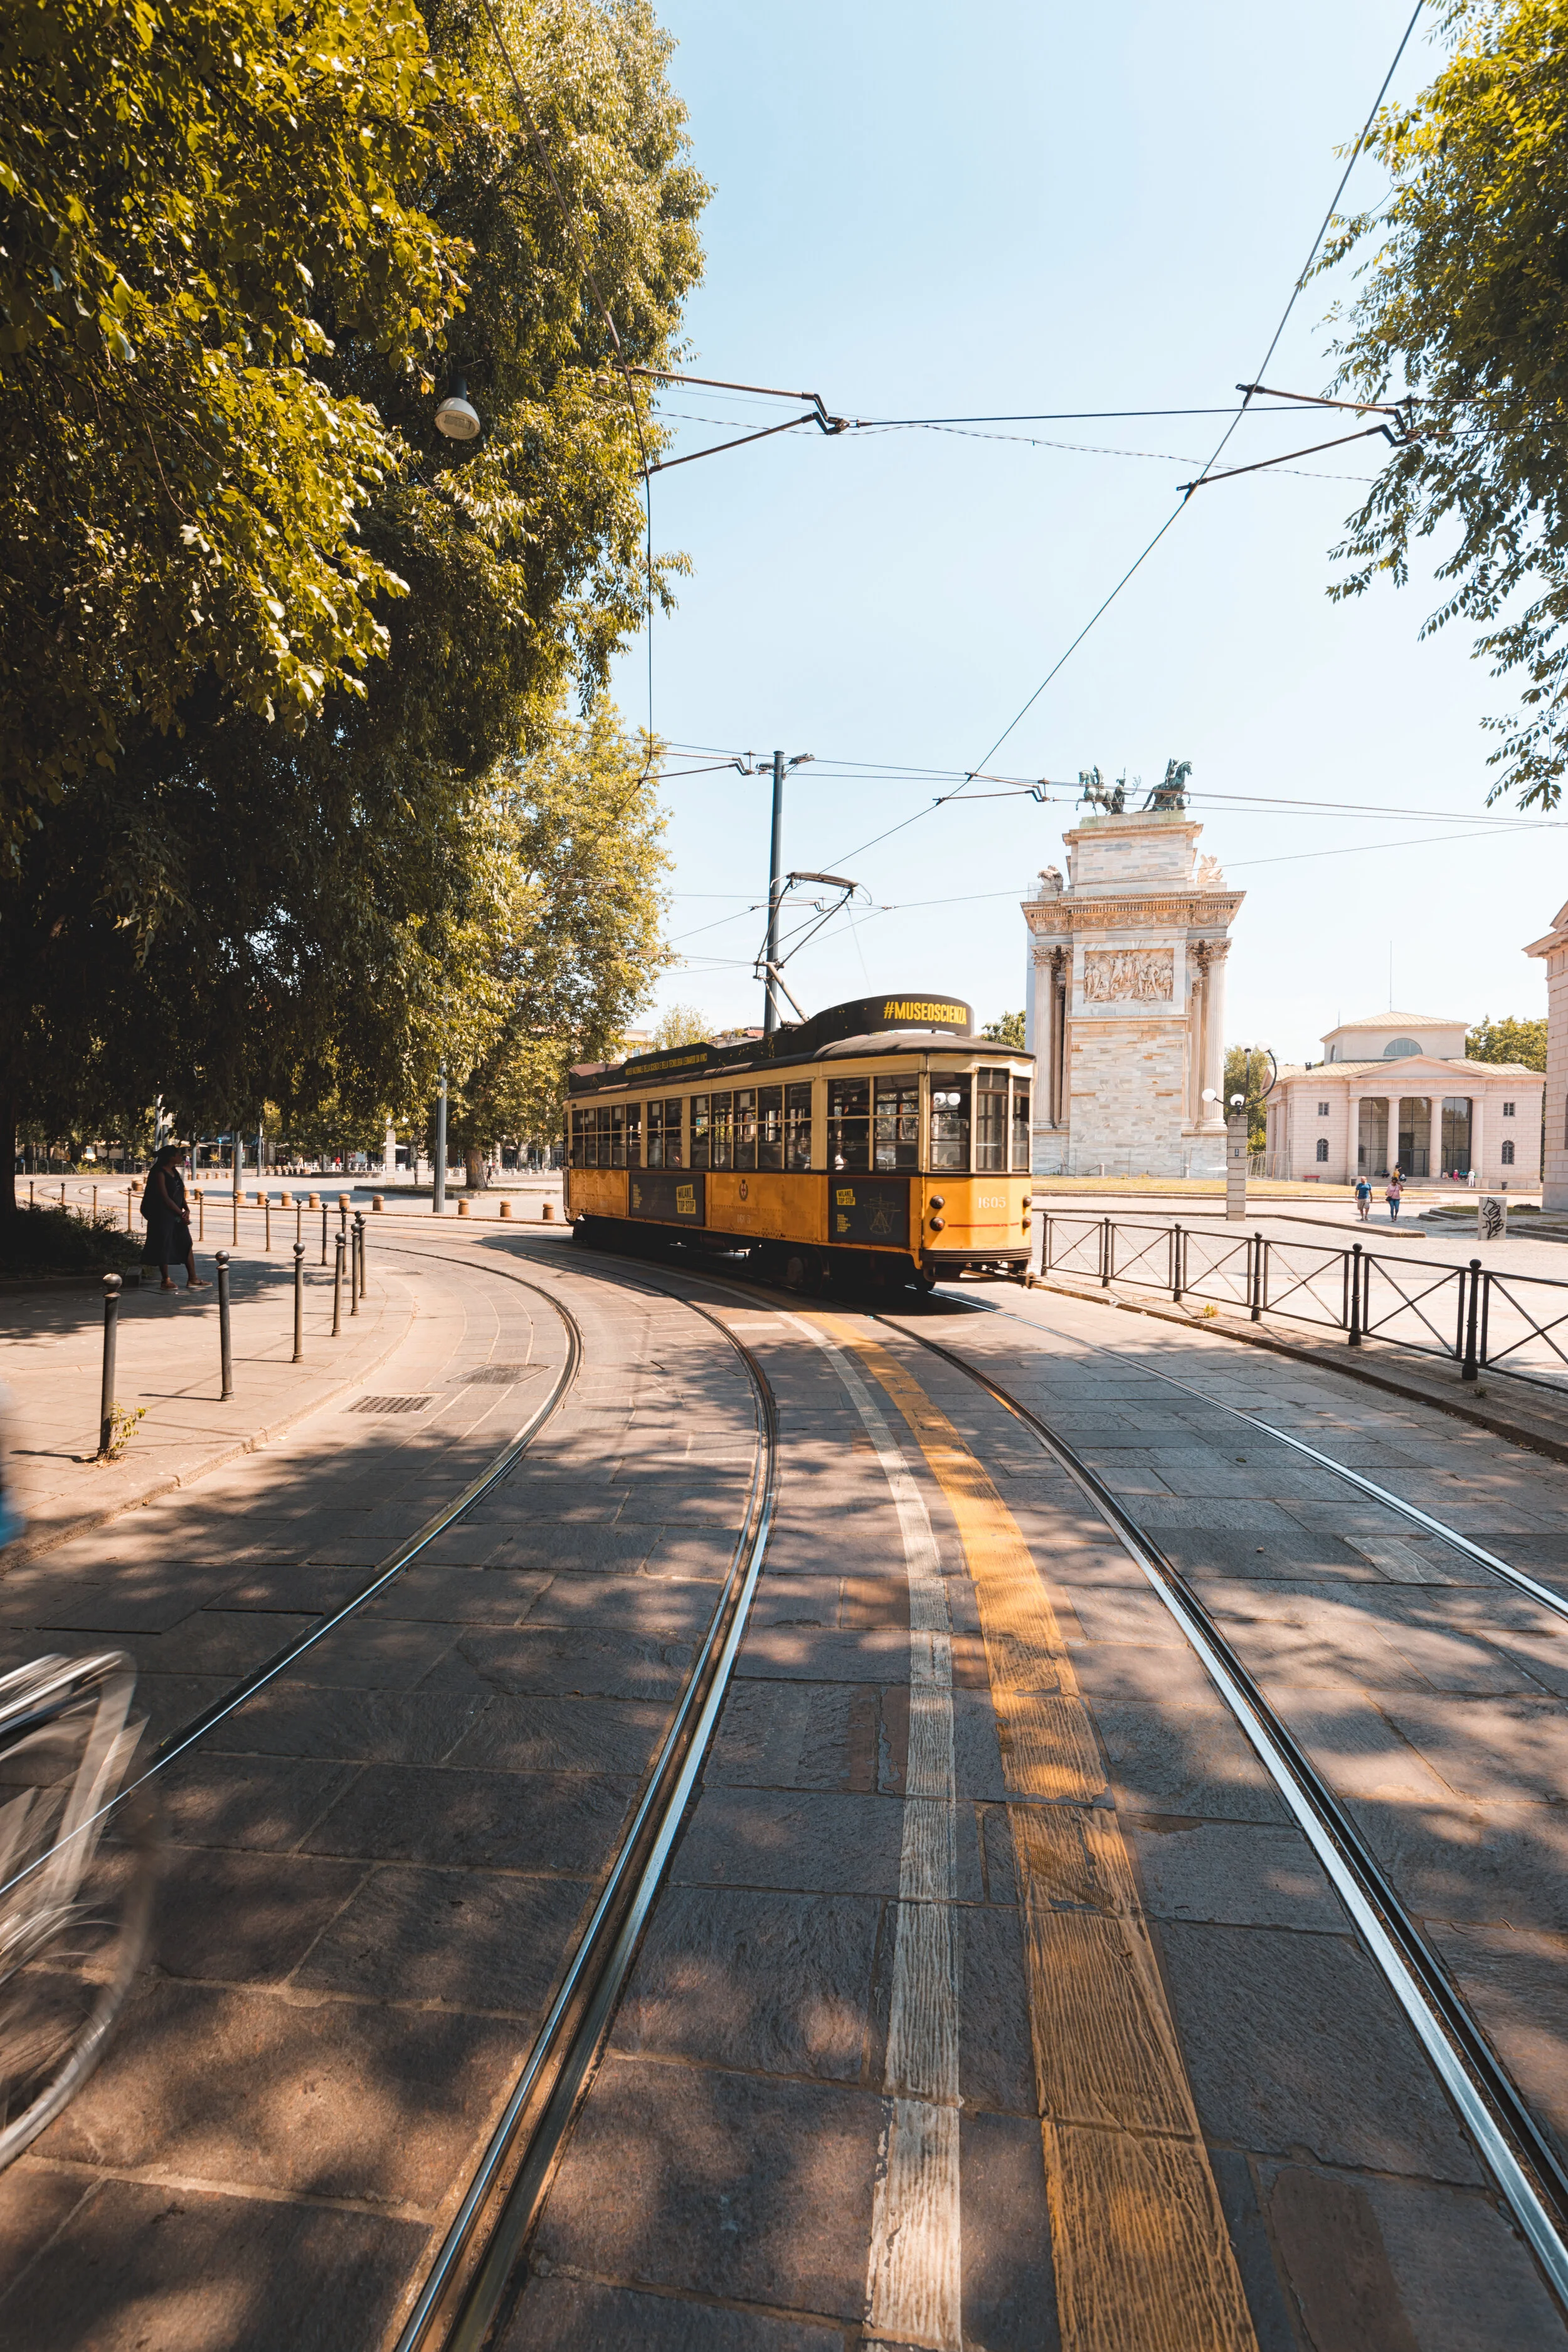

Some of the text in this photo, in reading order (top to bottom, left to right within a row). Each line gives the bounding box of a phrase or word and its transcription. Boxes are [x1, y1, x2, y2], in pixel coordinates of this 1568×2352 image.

[883, 1002, 967, 1025] #MUSEOSCIENZA
[678, 1187, 691, 1198] MILANO
[686, 1200, 694, 1212] STOP
[978, 1196, 1006, 1209] 1605
